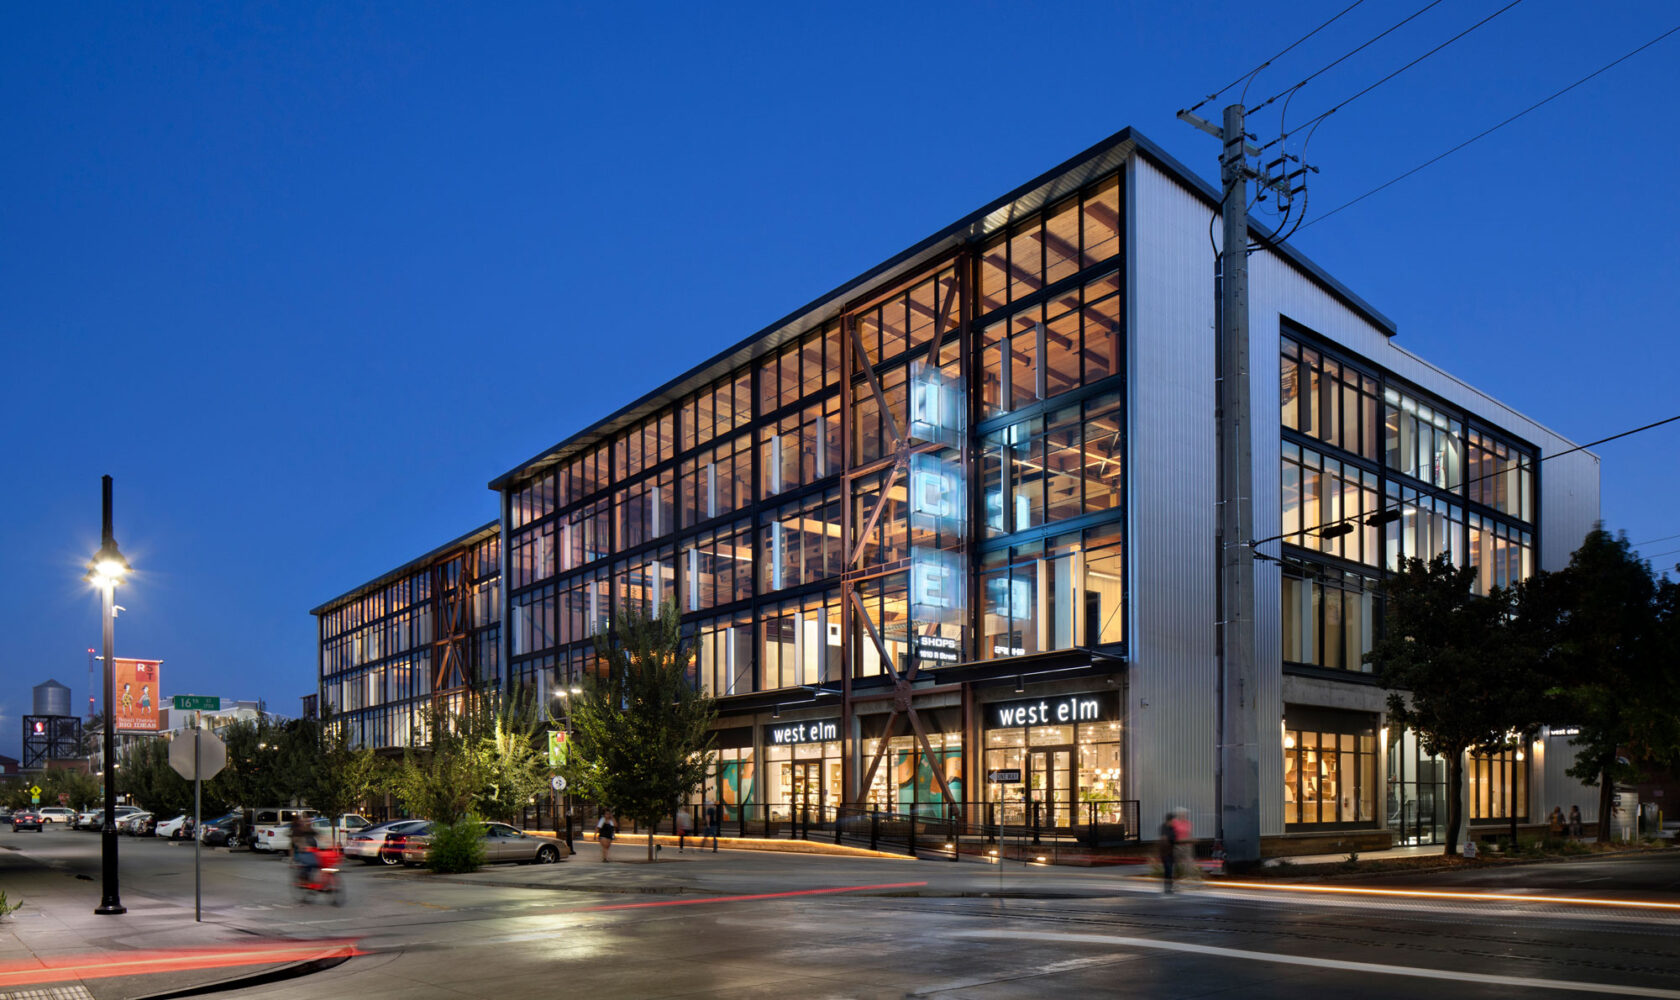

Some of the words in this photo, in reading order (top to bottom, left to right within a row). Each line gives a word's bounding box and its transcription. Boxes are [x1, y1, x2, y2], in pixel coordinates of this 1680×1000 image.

[921, 637, 956, 648] SHOPS
[939, 652, 957, 661] Street
[1000, 701, 1049, 726] west
[1057, 698, 1098, 721] elm
[774, 724, 806, 743] west
[810, 722, 836, 741] elm
